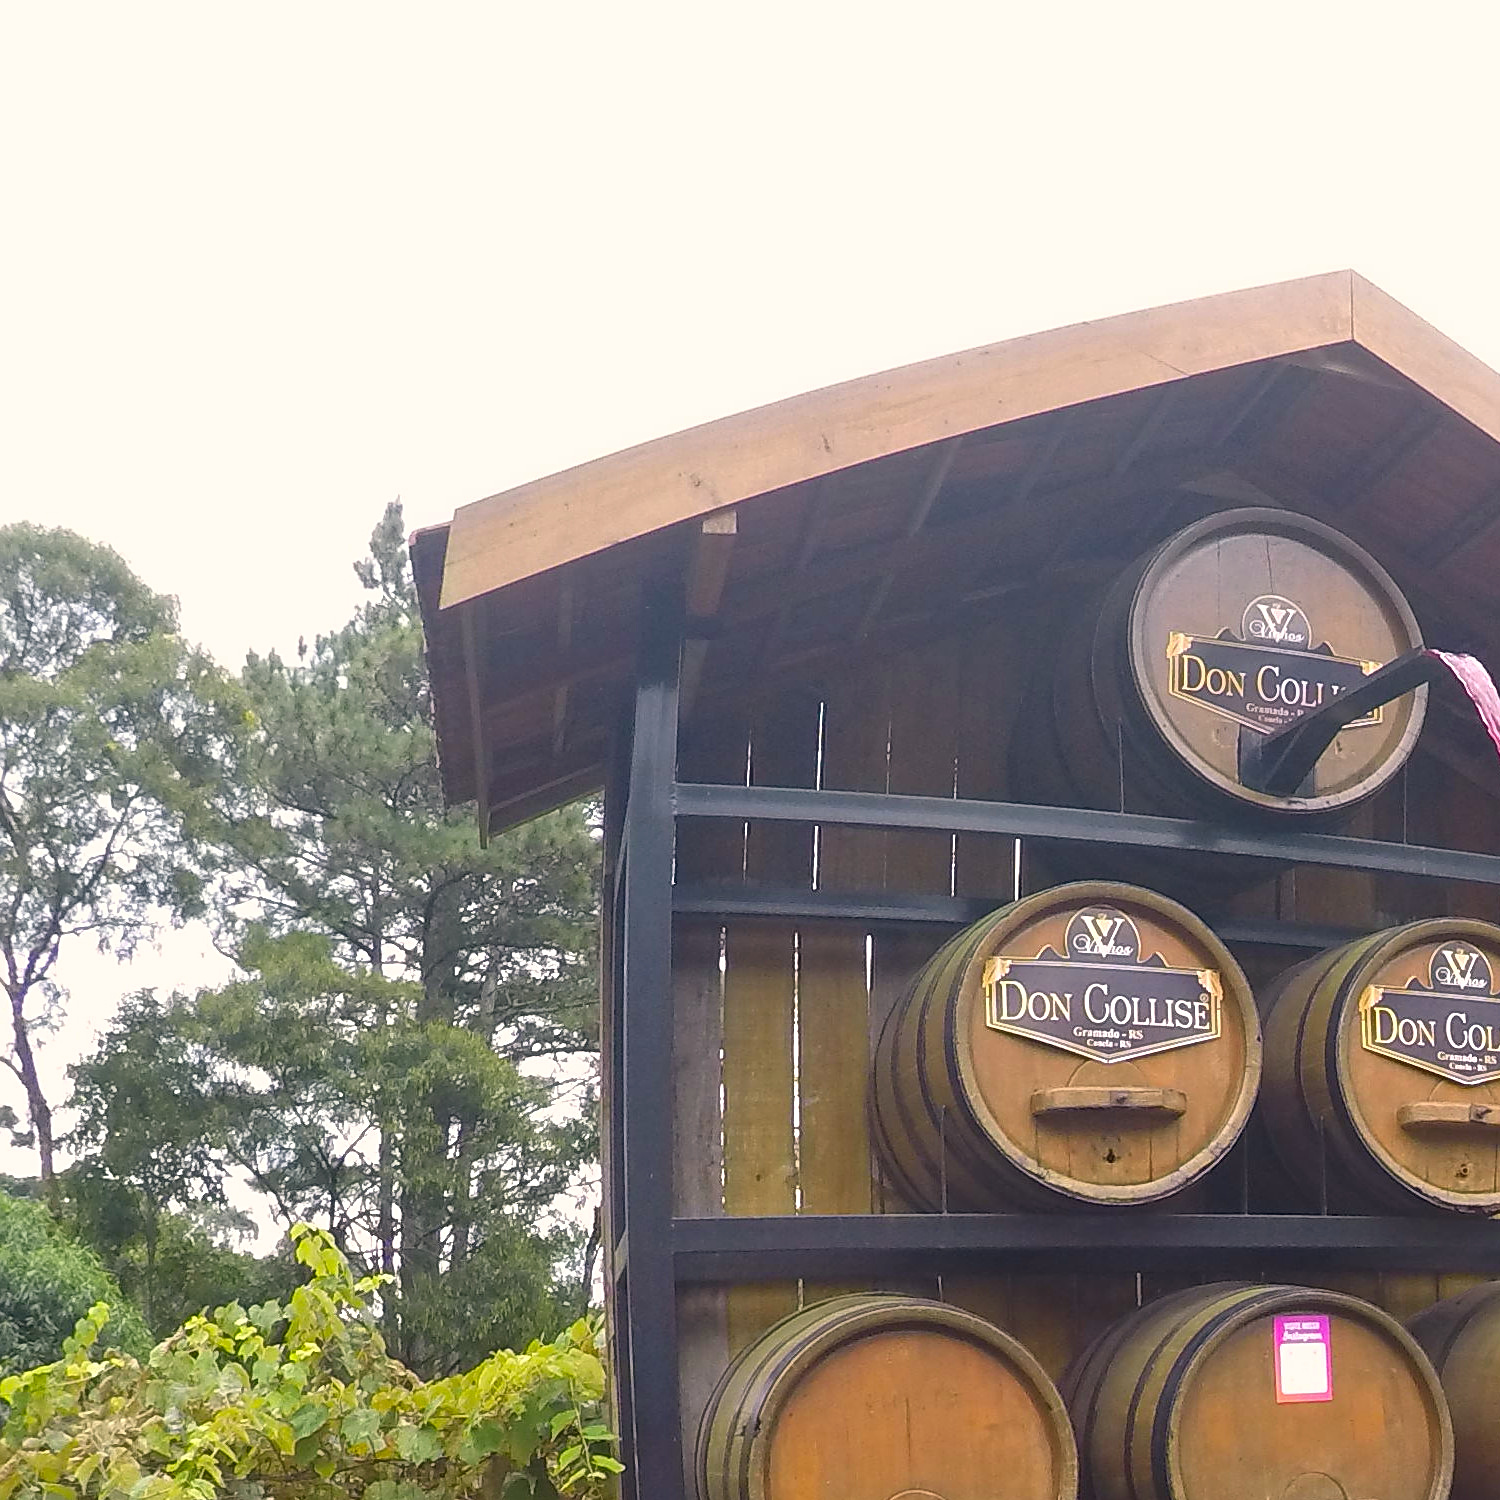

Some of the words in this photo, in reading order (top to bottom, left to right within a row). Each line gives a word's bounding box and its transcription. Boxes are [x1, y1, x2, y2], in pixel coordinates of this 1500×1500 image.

[1181, 654, 1247, 699] DON
[999, 980, 1072, 1021] DON
[1084, 983, 1210, 1030] COLLISE
[1073, 1026, 1120, 1039] Gramado
[1128, 1029, 1144, 1040] RS
[1373, 1006, 1437, 1047] DON
[1437, 1051, 1477, 1063] Gramado
[1484, 1055, 1498, 1065] RS
